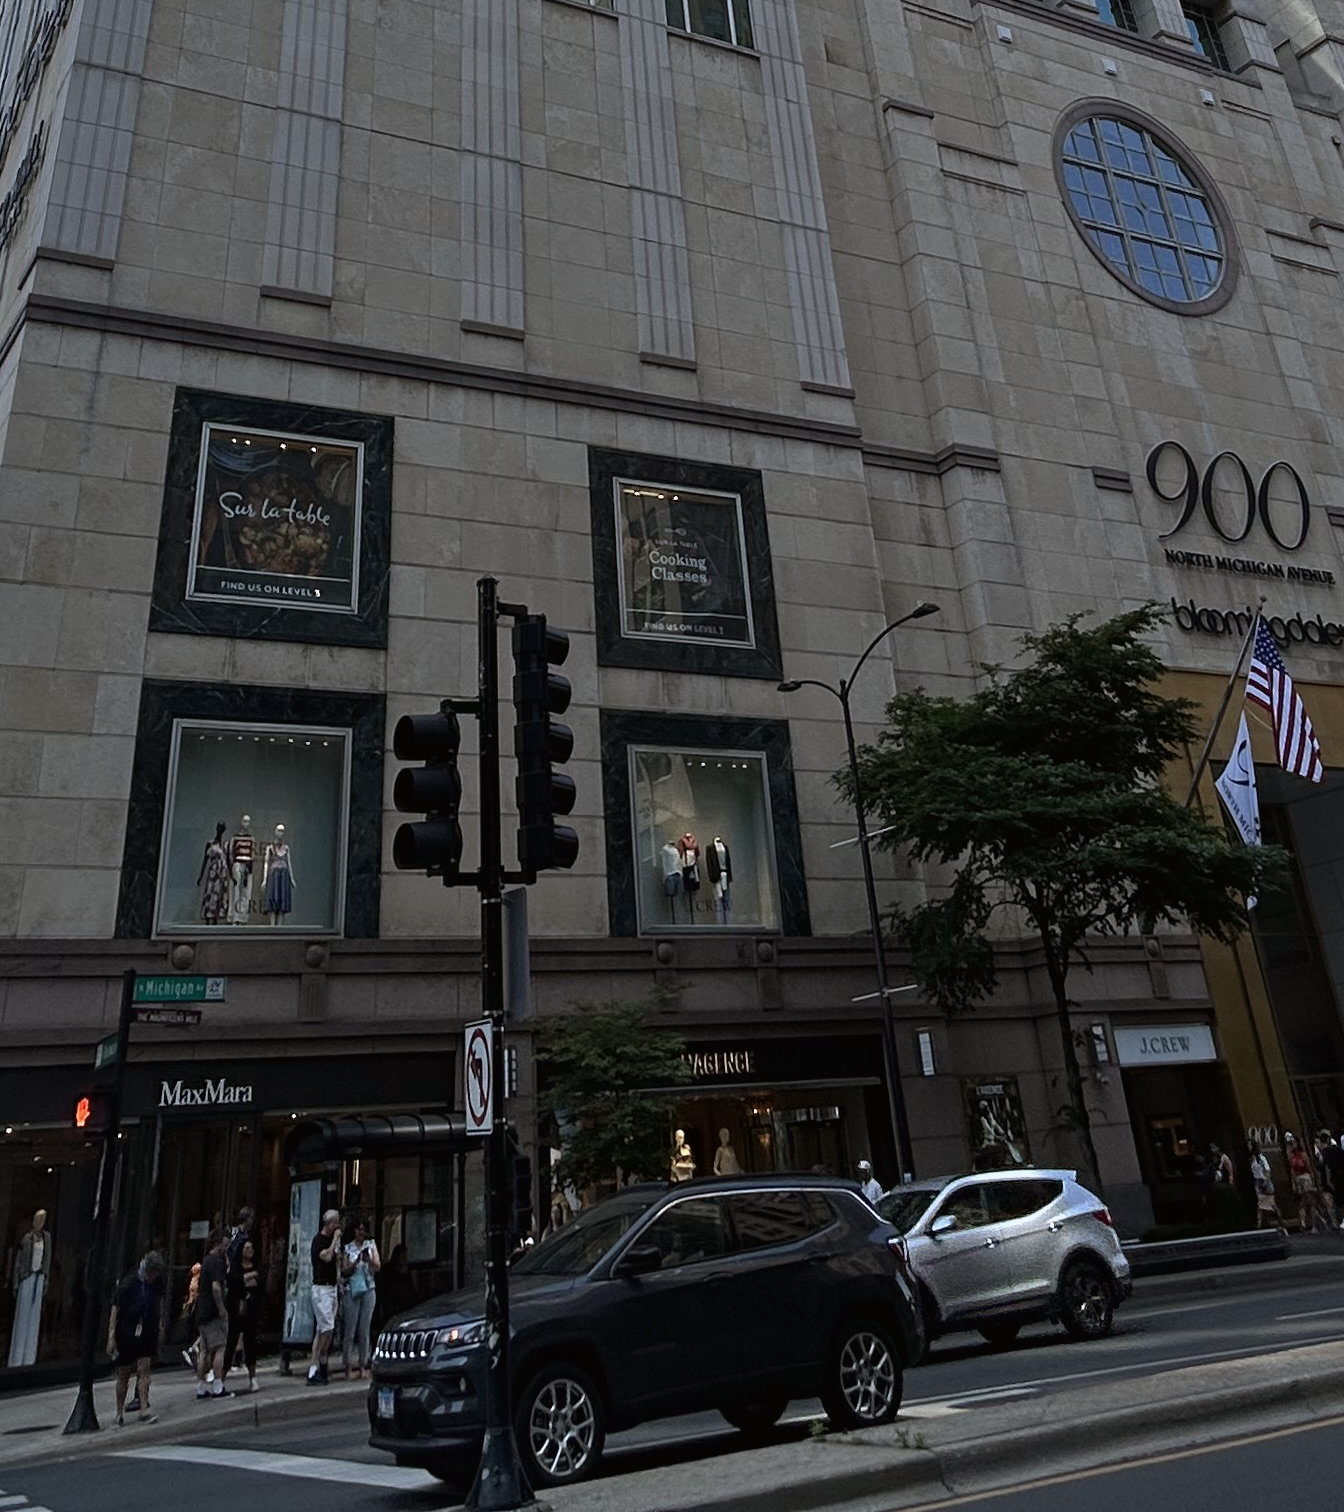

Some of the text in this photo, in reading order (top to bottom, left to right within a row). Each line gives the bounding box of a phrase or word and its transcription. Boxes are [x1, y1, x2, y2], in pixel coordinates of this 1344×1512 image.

[1146, 440, 1311, 552] 900
[219, 492, 331, 527] Sur la table
[649, 550, 707, 571] Cooking
[1164, 549, 1336, 585] NORTH MICHIGAN AVENUE
[651, 567, 708, 584] Classes
[221, 580, 246, 591] FIND
[247, 584, 262, 592] US
[264, 585, 278, 593] ON
[282, 586, 313, 597] LEVEL
[146, 979, 195, 1000] Michigan
[1140, 1035, 1190, 1055] J.CREW
[158, 1078, 254, 1107] MaxMara
